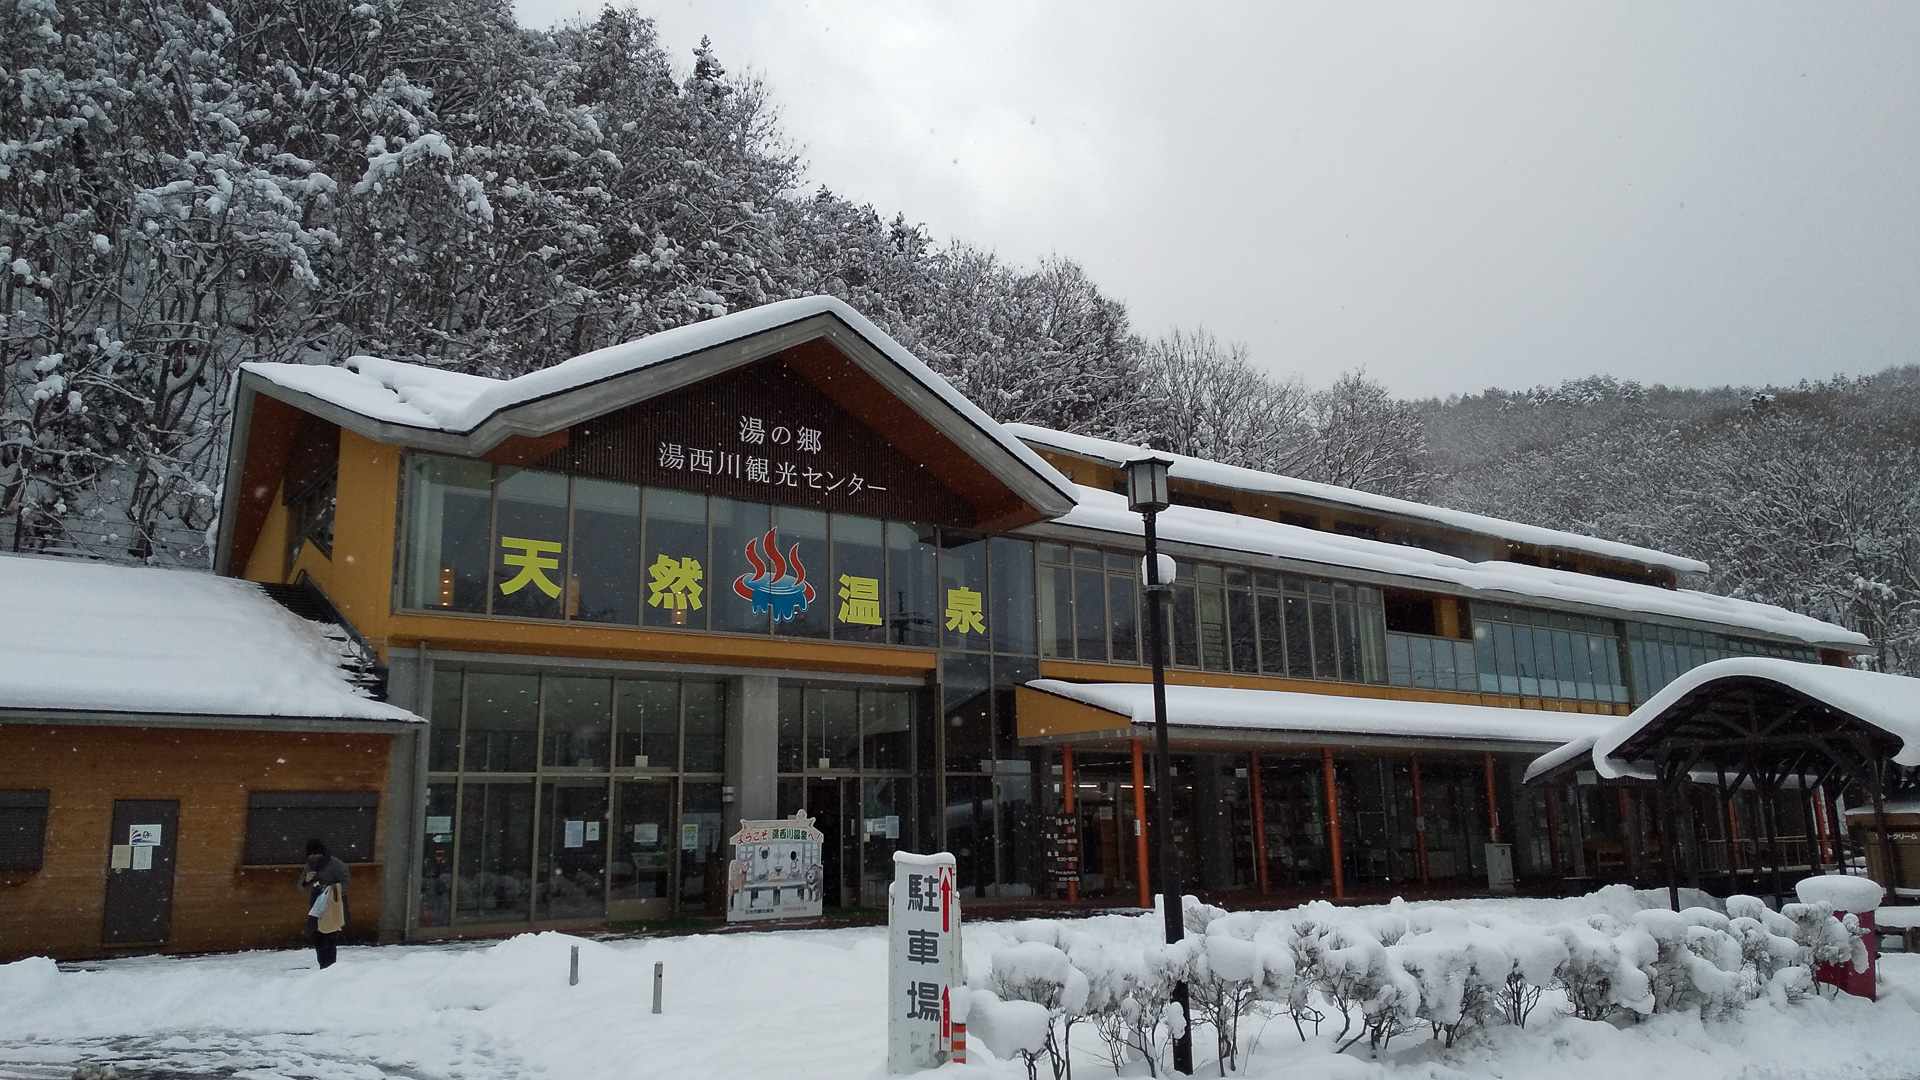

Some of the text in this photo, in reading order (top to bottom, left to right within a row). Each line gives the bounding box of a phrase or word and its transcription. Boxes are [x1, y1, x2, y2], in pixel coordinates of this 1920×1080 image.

[739, 415, 822, 454] 湯の郷
[658, 441, 887, 495] 湯西川観光センター
[906, 874, 940, 1022] 駐車場
